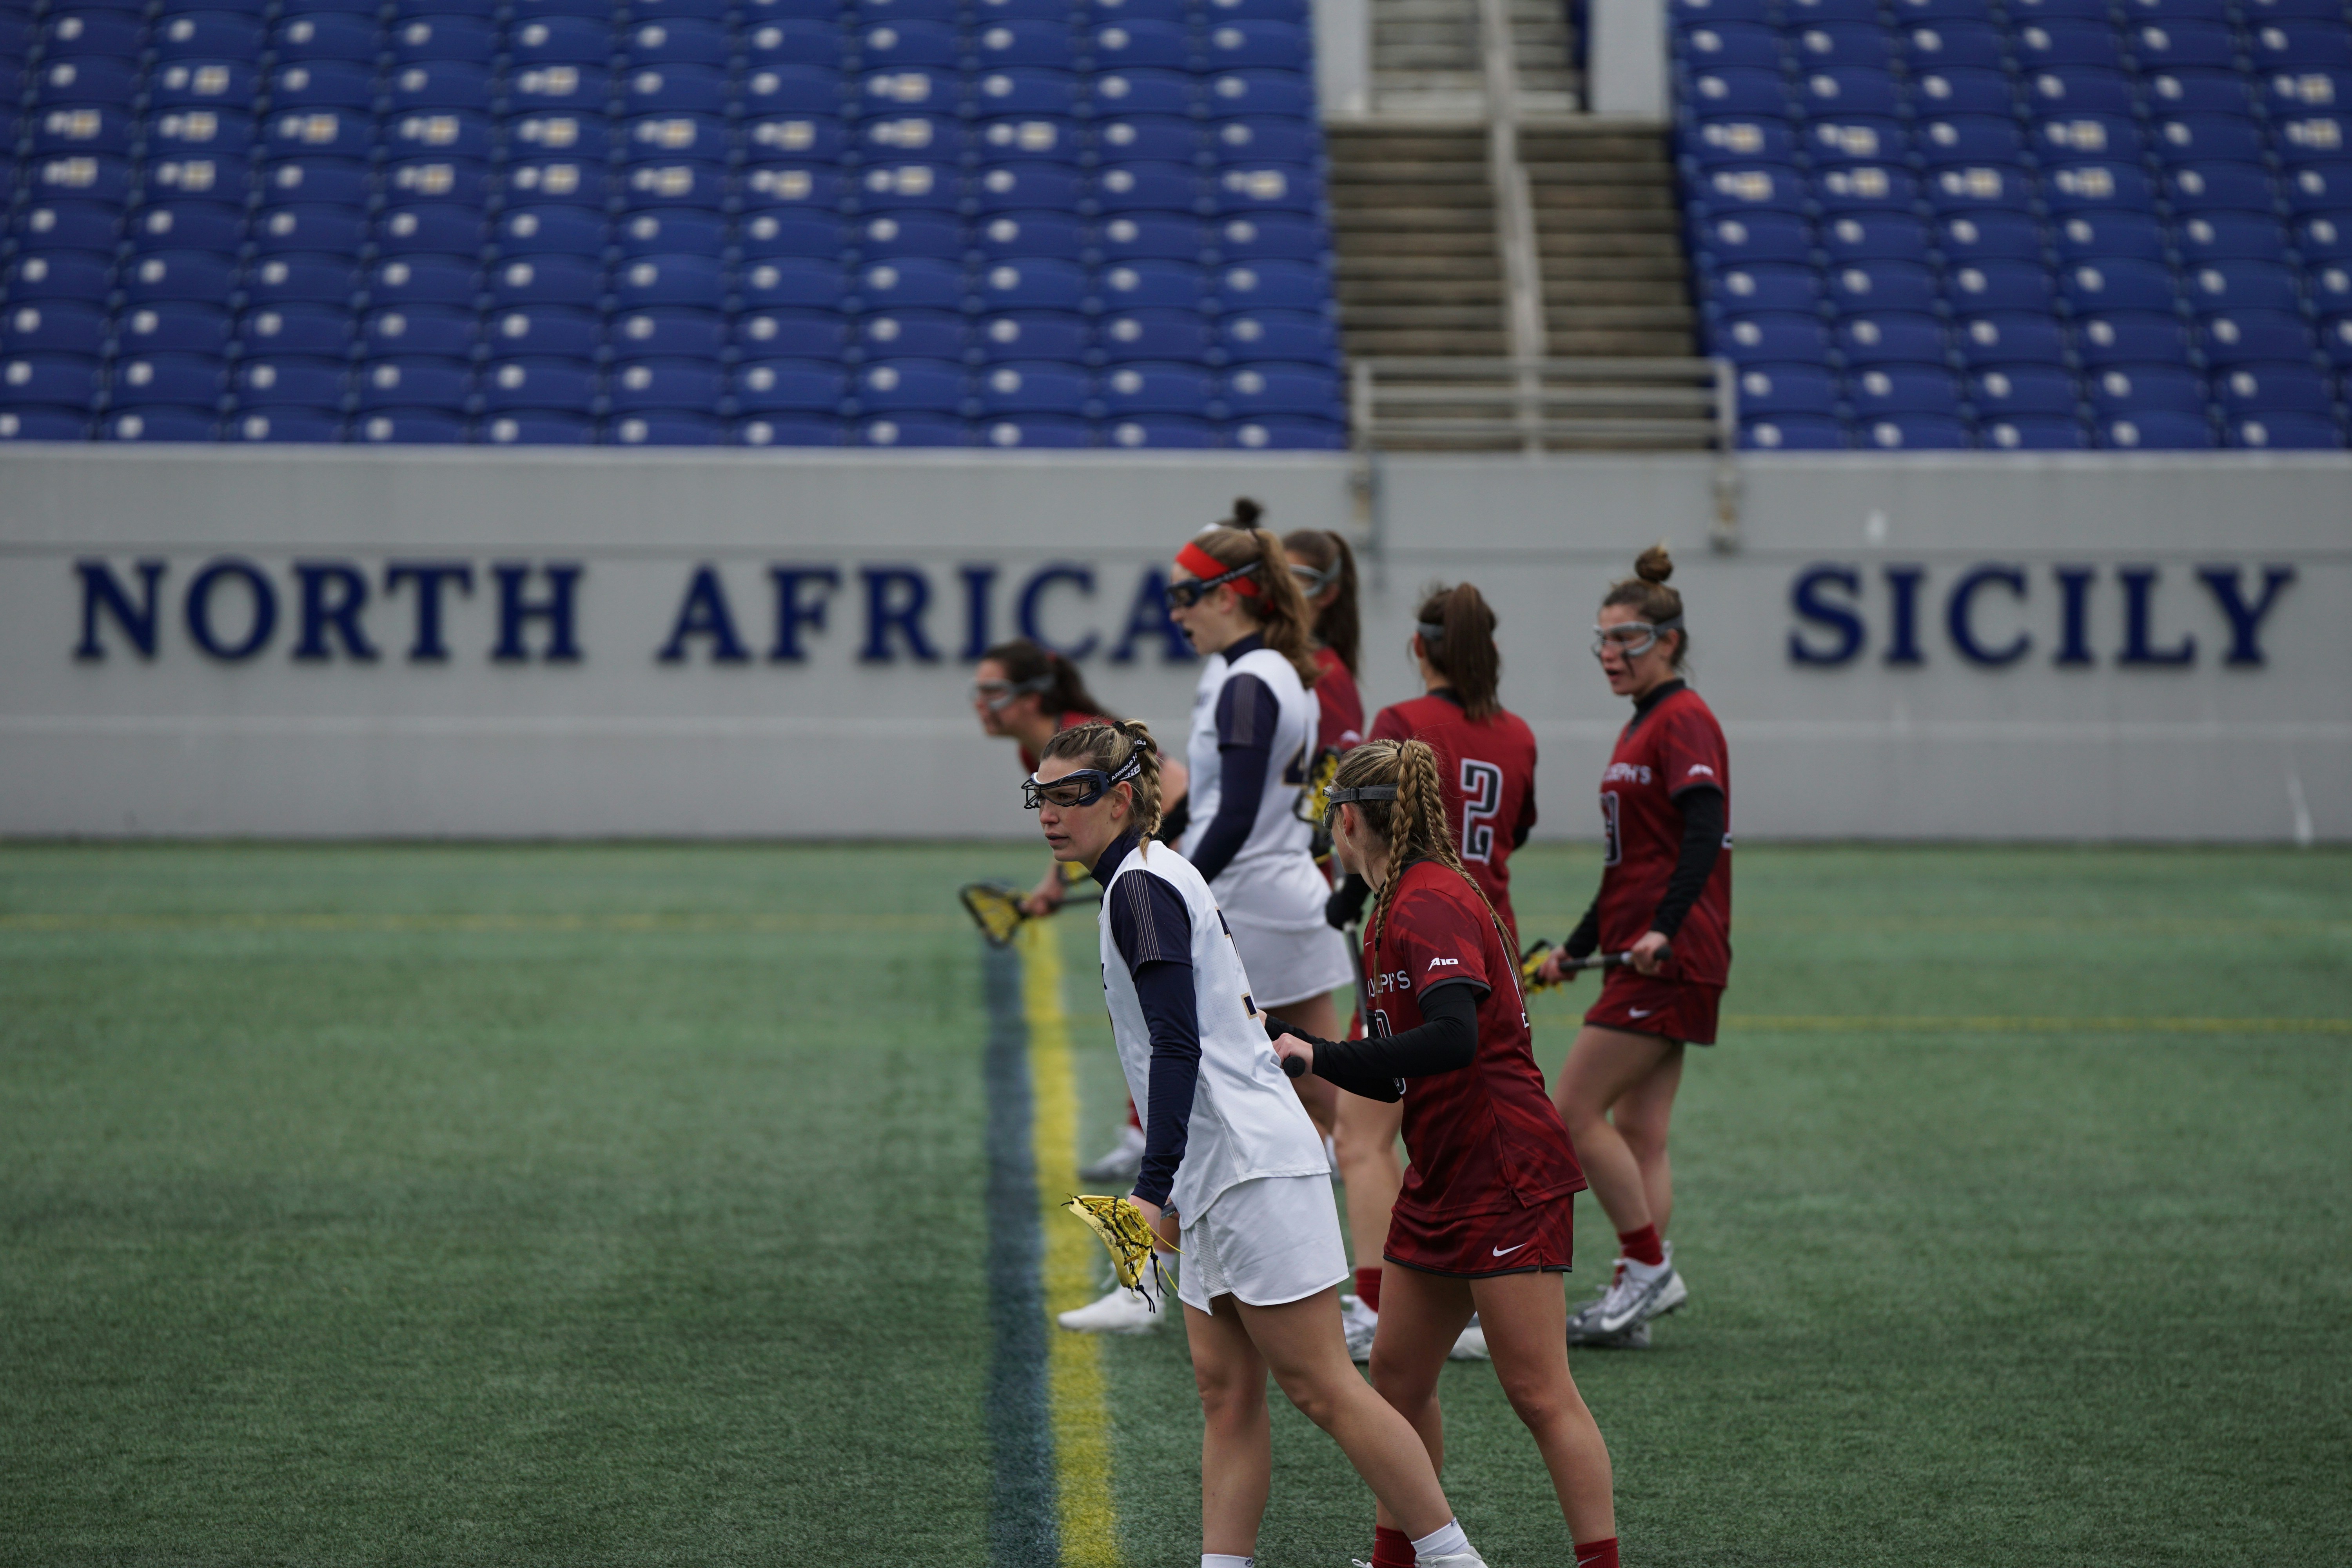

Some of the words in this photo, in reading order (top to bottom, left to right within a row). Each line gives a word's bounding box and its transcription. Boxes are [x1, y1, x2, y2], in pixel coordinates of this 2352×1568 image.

[73, 557, 585, 662] NORTH
[655, 559, 1202, 663] AFRICA
[1788, 560, 2293, 666] SICILY
[1111, 759, 1134, 781] ARMOUR
[1460, 757, 1503, 865] 2
[1427, 957, 1459, 971] A10
